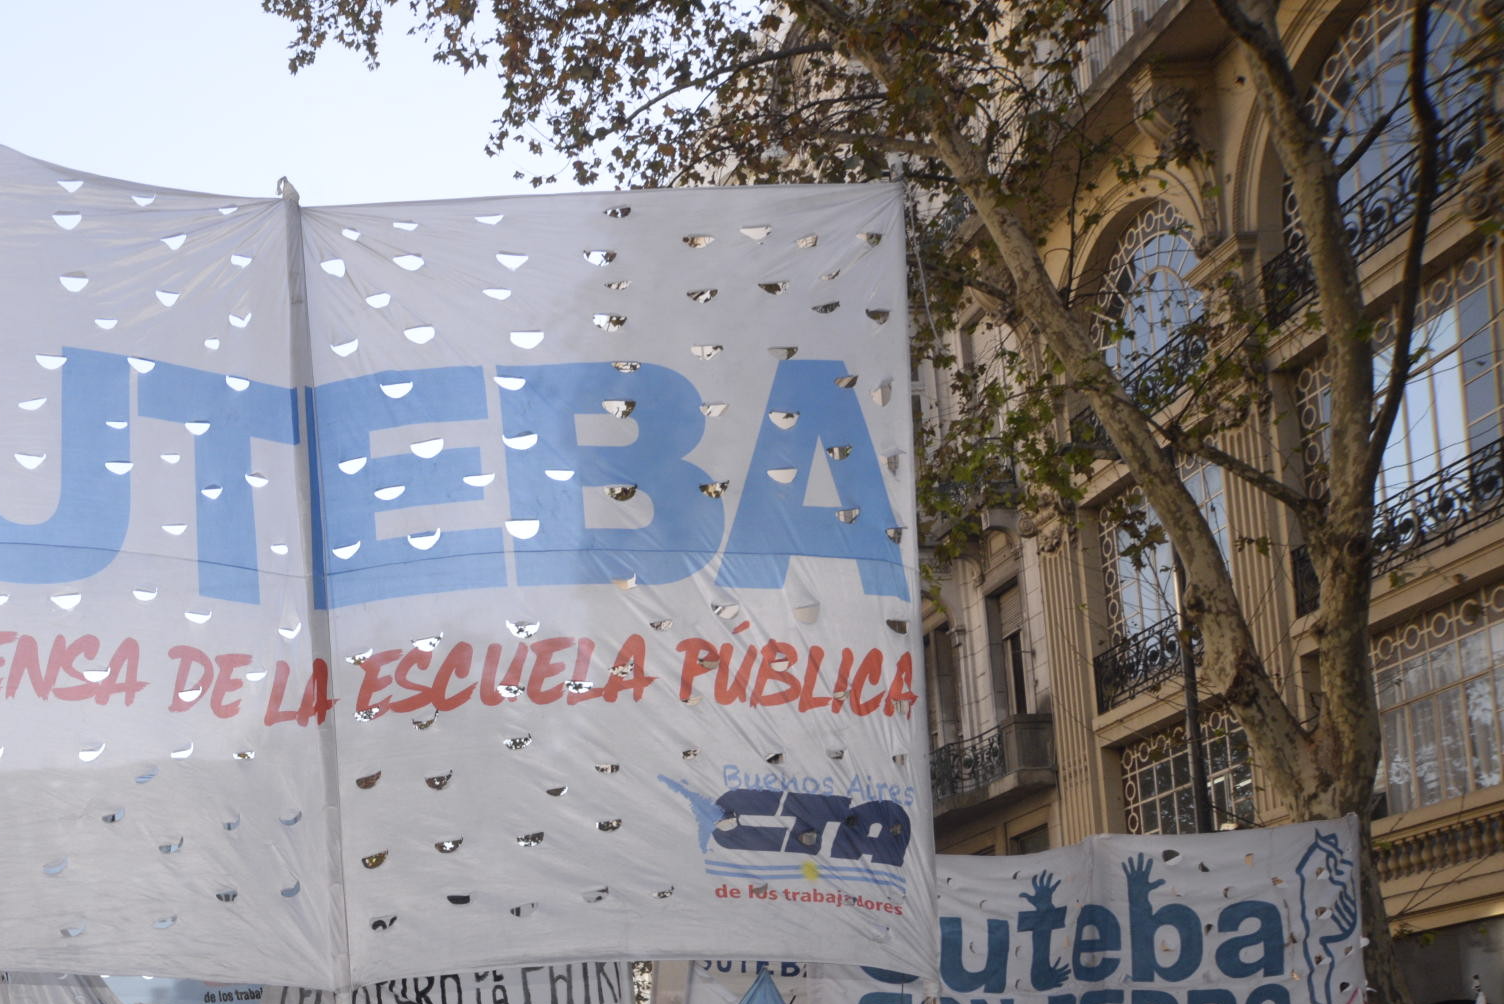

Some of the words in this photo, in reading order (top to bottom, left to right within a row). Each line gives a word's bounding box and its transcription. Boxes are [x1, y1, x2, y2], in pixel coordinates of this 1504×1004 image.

[168, 644, 254, 720] DE
[263, 657, 340, 728] LA
[355, 634, 657, 717] ESCUELA
[675, 621, 919, 722] PÚBLICA
[723, 764, 834, 795] Buenos
[848, 774, 916, 806] Aires
[712, 788, 911, 868] CTA
[715, 884, 741, 899] de
[748, 884, 778, 900] los
[783, 888, 904, 916] trabajadores
[859, 853, 1286, 994] uteba
[204, 991, 216, 1004] de
[218, 990, 234, 1003] los
